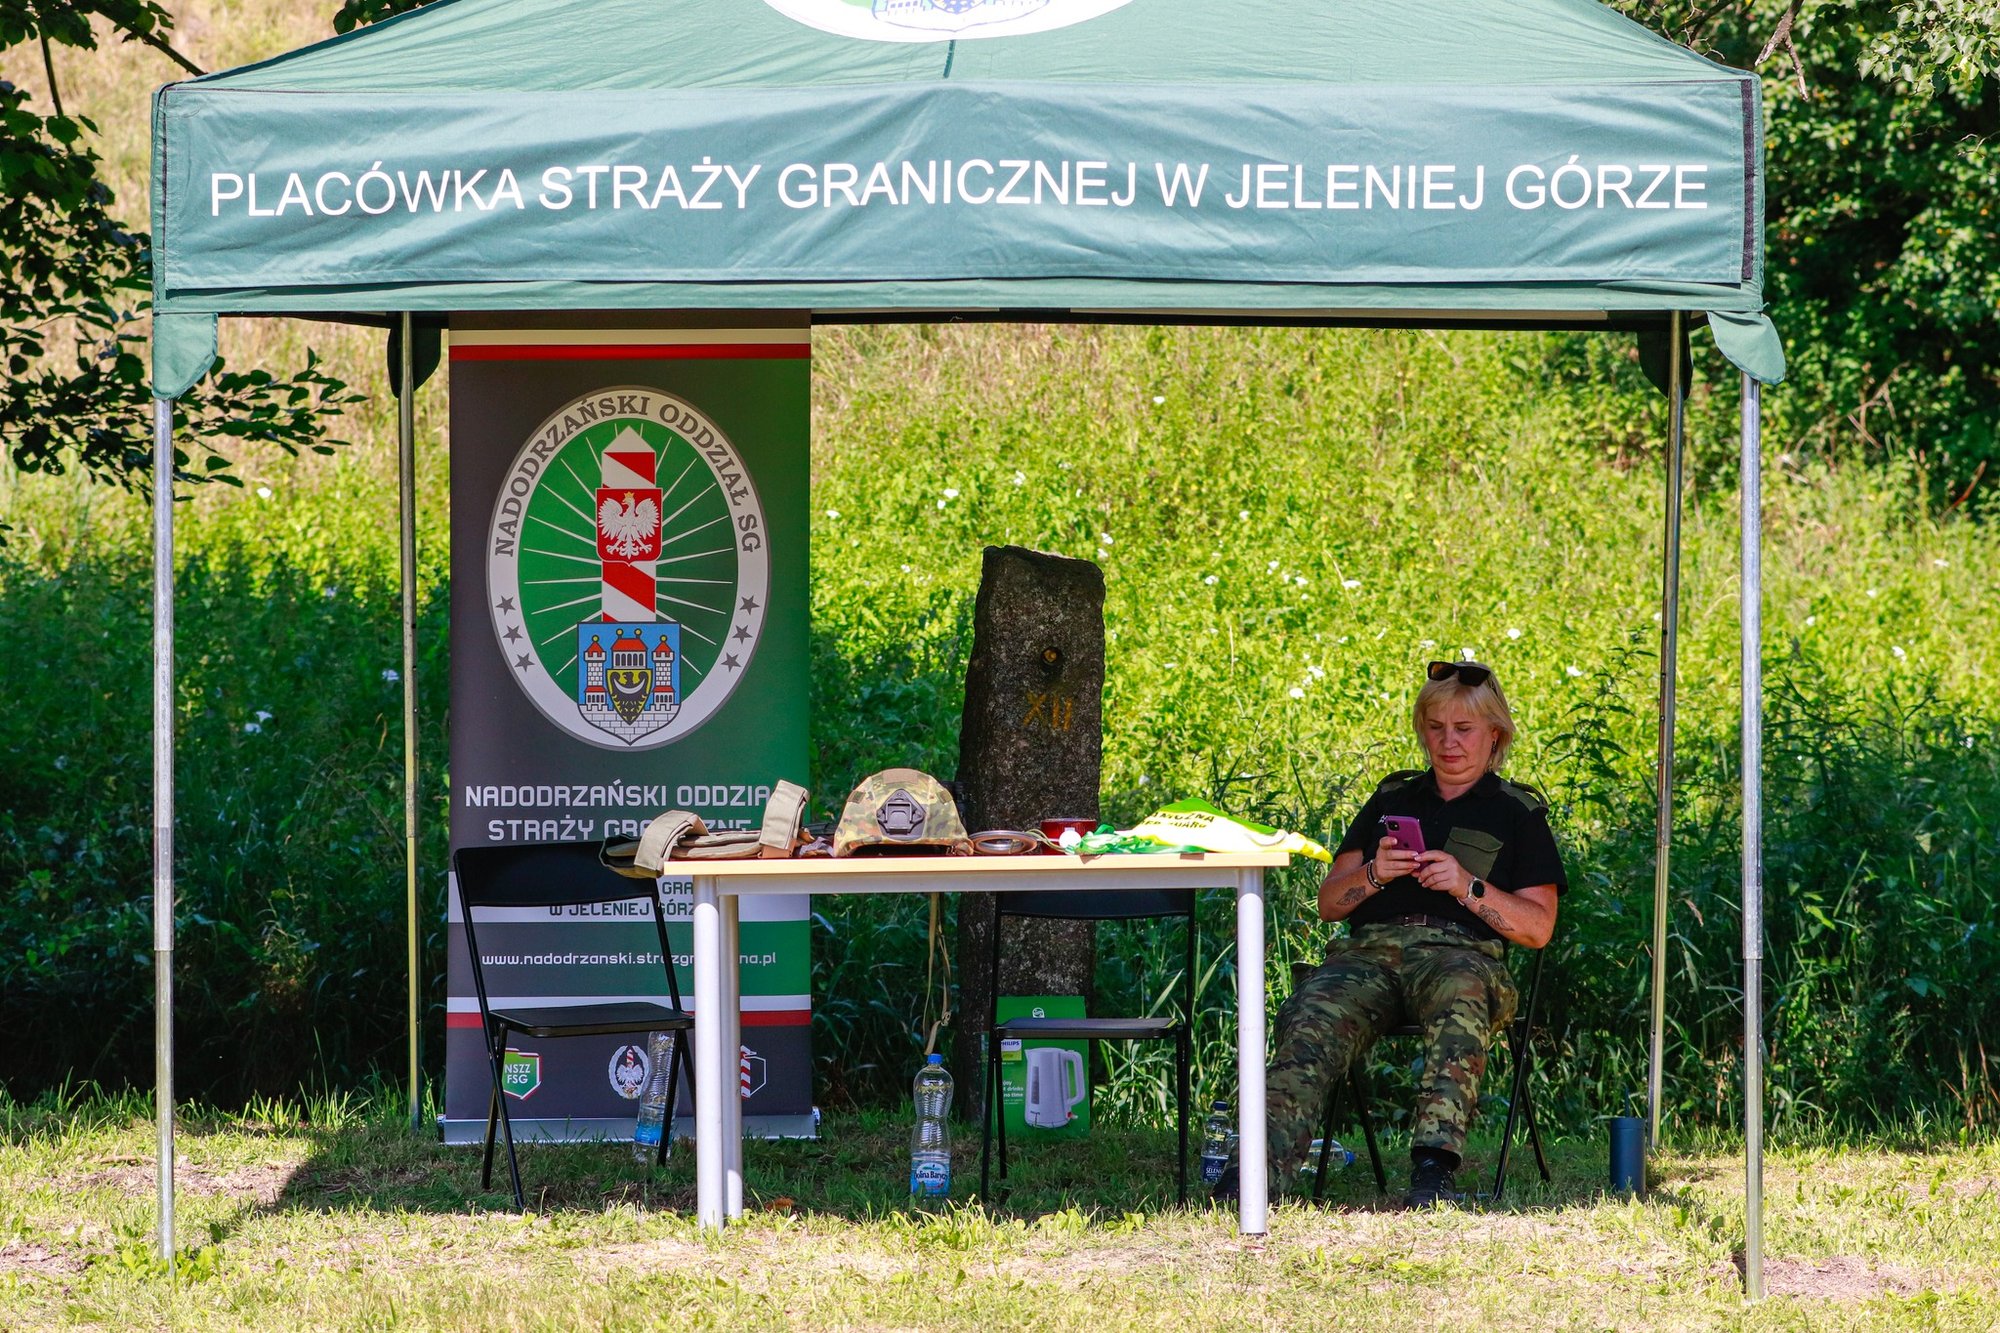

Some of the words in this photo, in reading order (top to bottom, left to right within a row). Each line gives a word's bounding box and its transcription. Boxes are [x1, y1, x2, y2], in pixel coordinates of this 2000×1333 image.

[212, 161, 524, 216] PLACÓWKA
[540, 157, 760, 209] STRAŻY
[779, 160, 1135, 208] GRANICZNEJ
[1156, 163, 1208, 206] W
[1226, 165, 1483, 209] JELENIEJ
[1506, 155, 1707, 209] GÓRZE
[495, 396, 650, 557] NADODRZAŃSKI
[659, 404, 749, 506] ODDZIAŁ
[737, 514, 761, 552] SG
[465, 778, 667, 807] NADODRZAŃSKI
[676, 785, 771, 807] ODDZIA
[488, 814, 594, 841] STRAŻY
[569, 902, 650, 916] JELENIEJ
[504, 1063, 531, 1074] NSZZ
[507, 1074, 528, 1084] FSG
